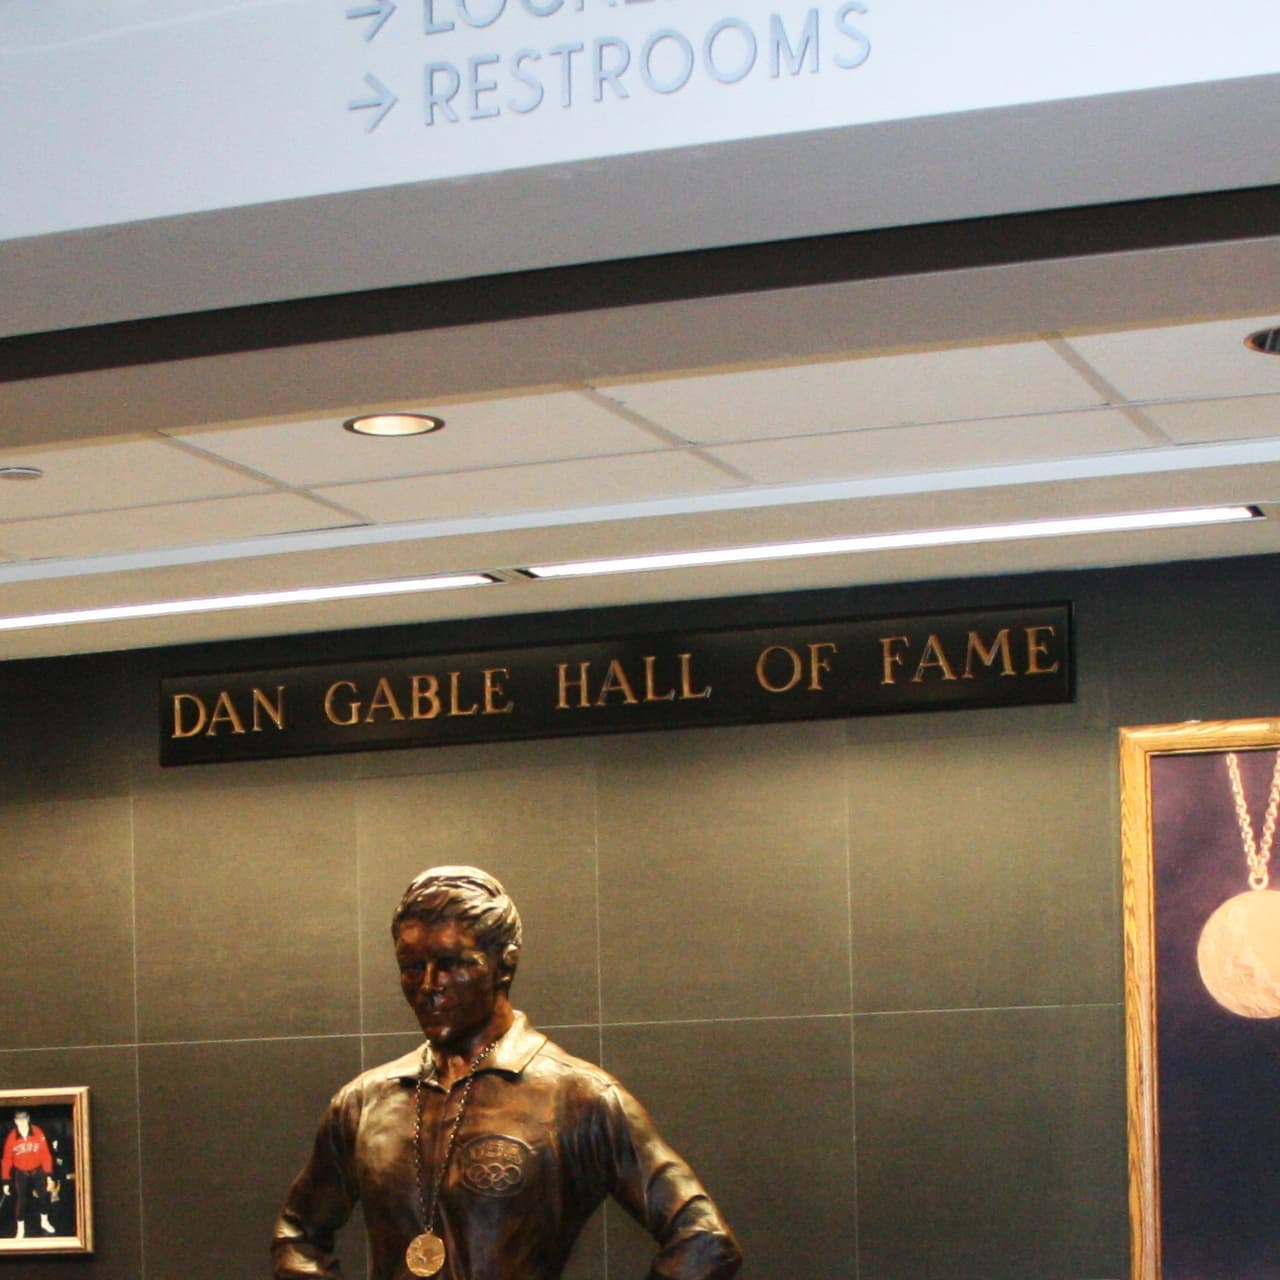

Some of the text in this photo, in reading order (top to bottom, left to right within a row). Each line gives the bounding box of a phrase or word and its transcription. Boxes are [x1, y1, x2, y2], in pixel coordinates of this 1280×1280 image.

[422, 1, 872, 127] RESTROOMS
[170, 624, 1062, 741] DAN GABLE HALL OF FAME
